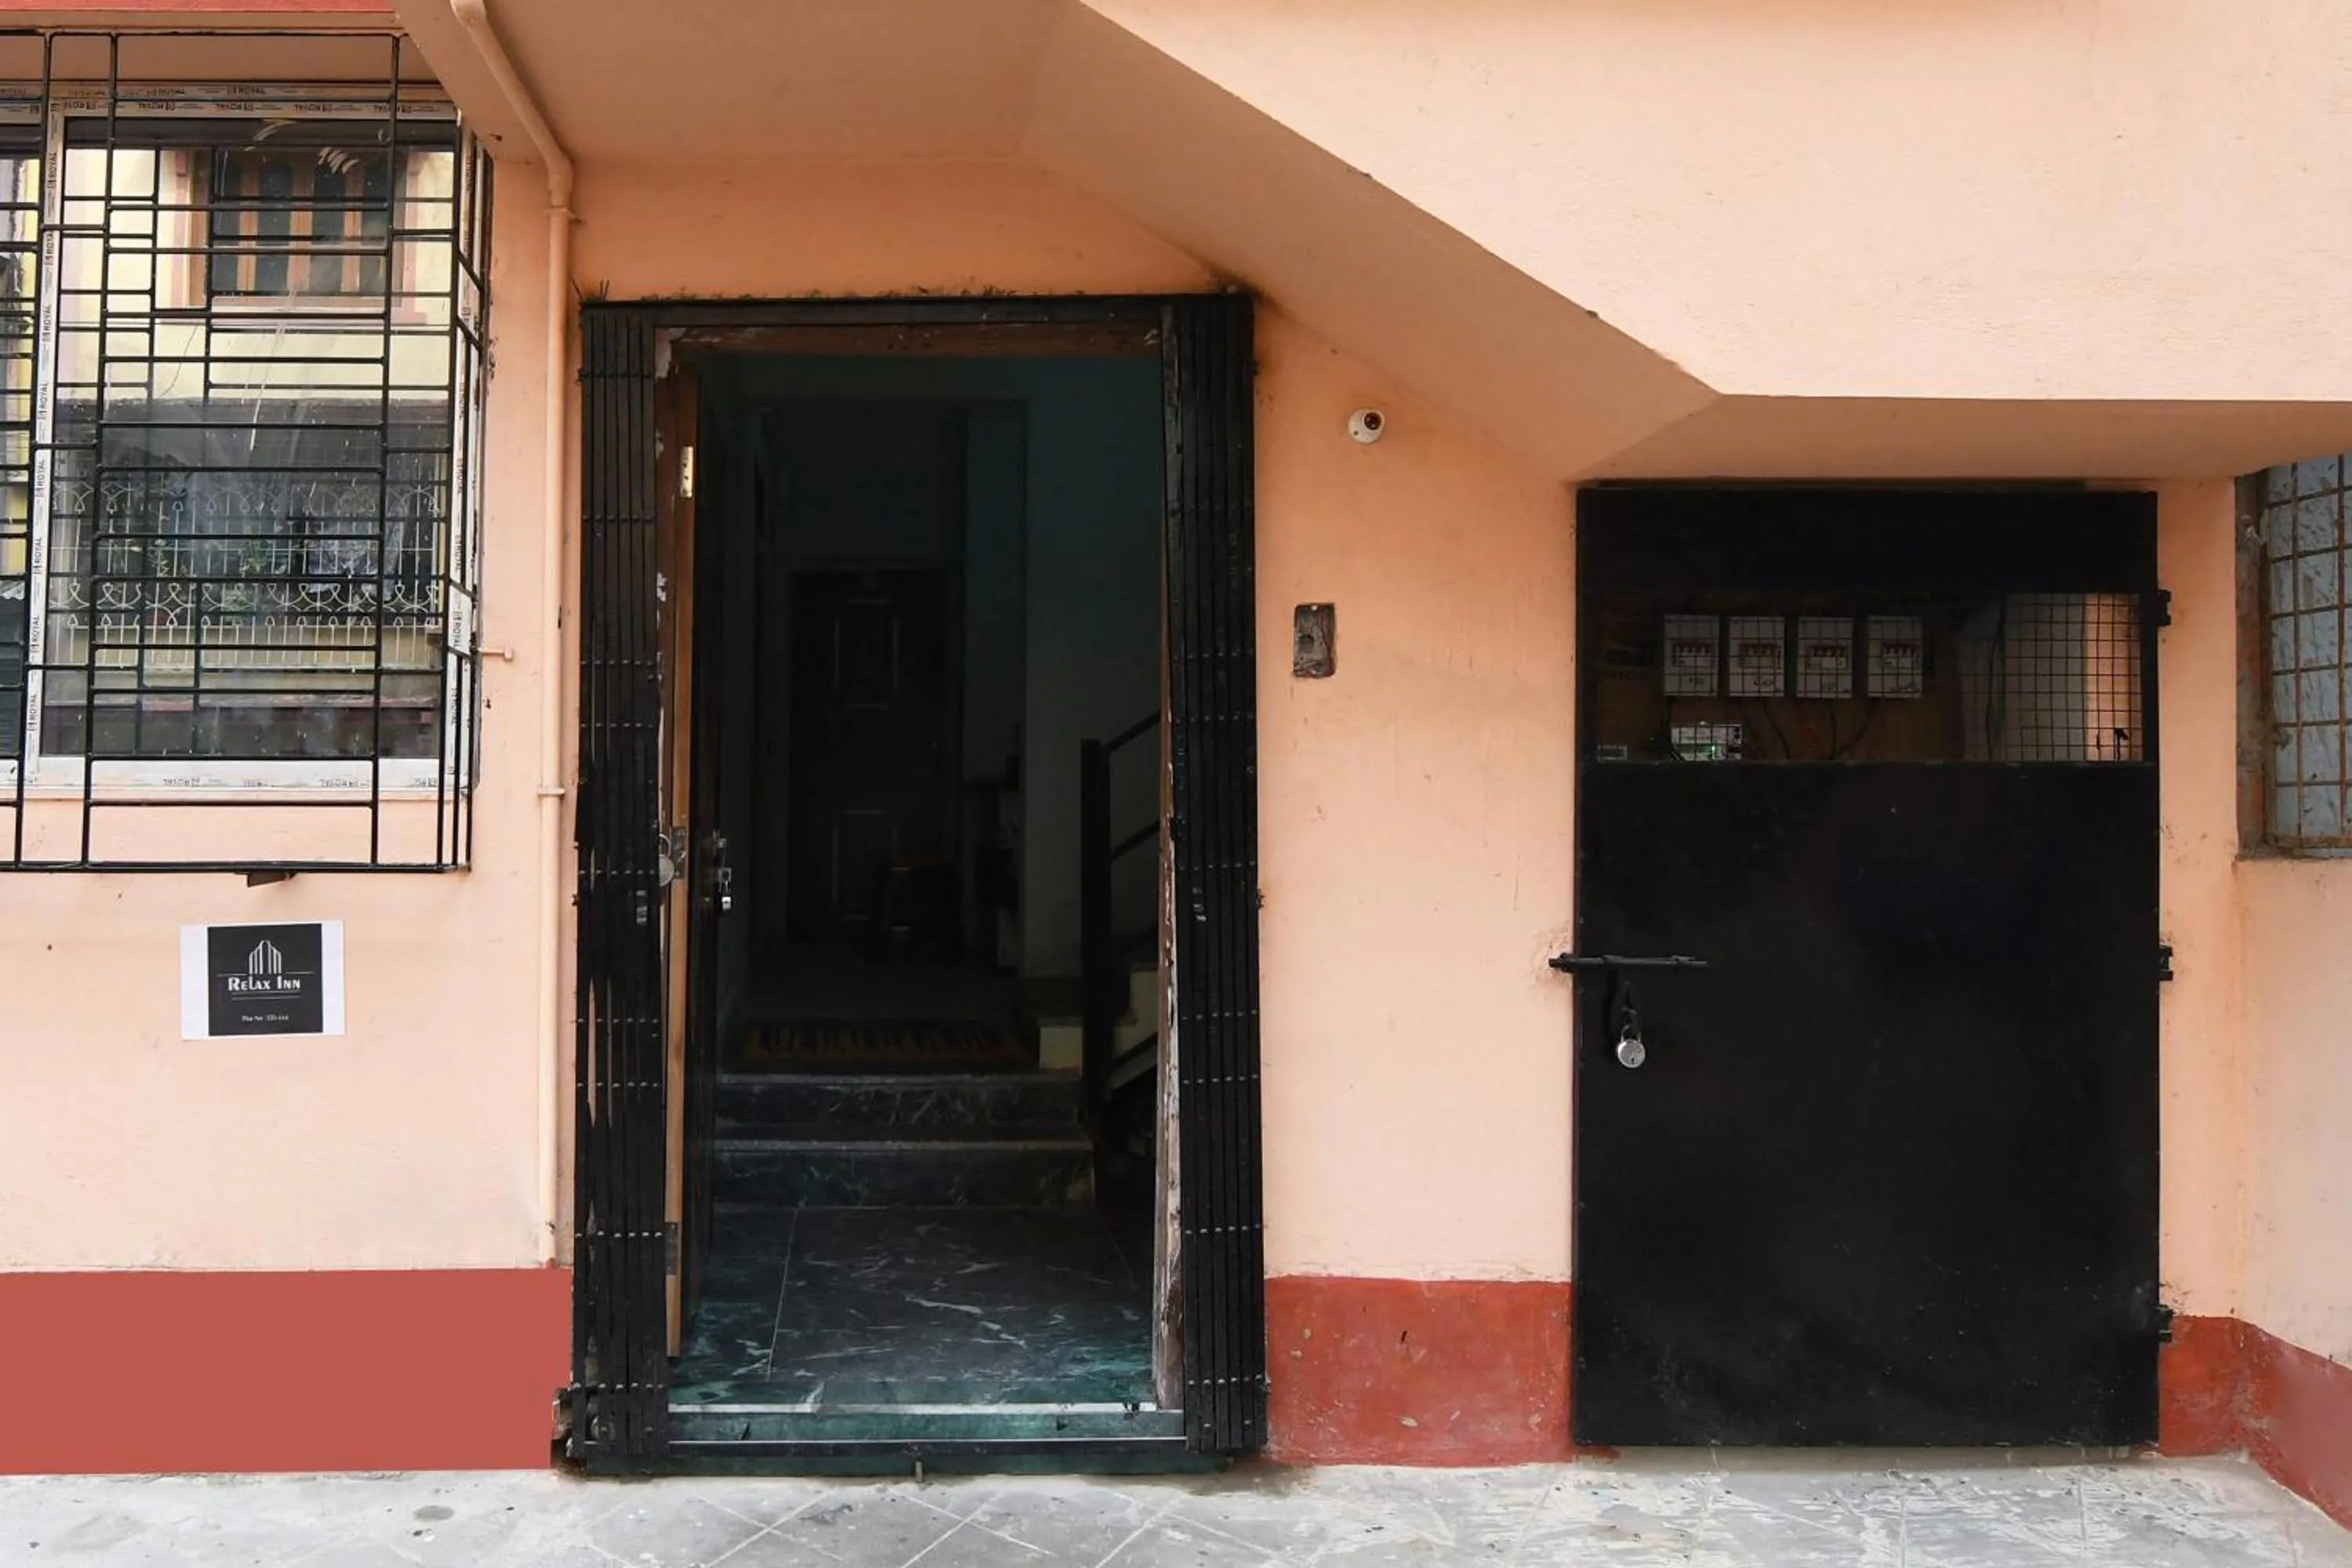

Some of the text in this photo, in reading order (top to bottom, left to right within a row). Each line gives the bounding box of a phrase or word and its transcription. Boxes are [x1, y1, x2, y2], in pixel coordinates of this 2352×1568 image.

[49, 152, 57, 179] ROYAL
[40, 382, 49, 410] ROYAL
[28, 694, 37, 720] ROYAL
[277, 975, 300, 990] INN
